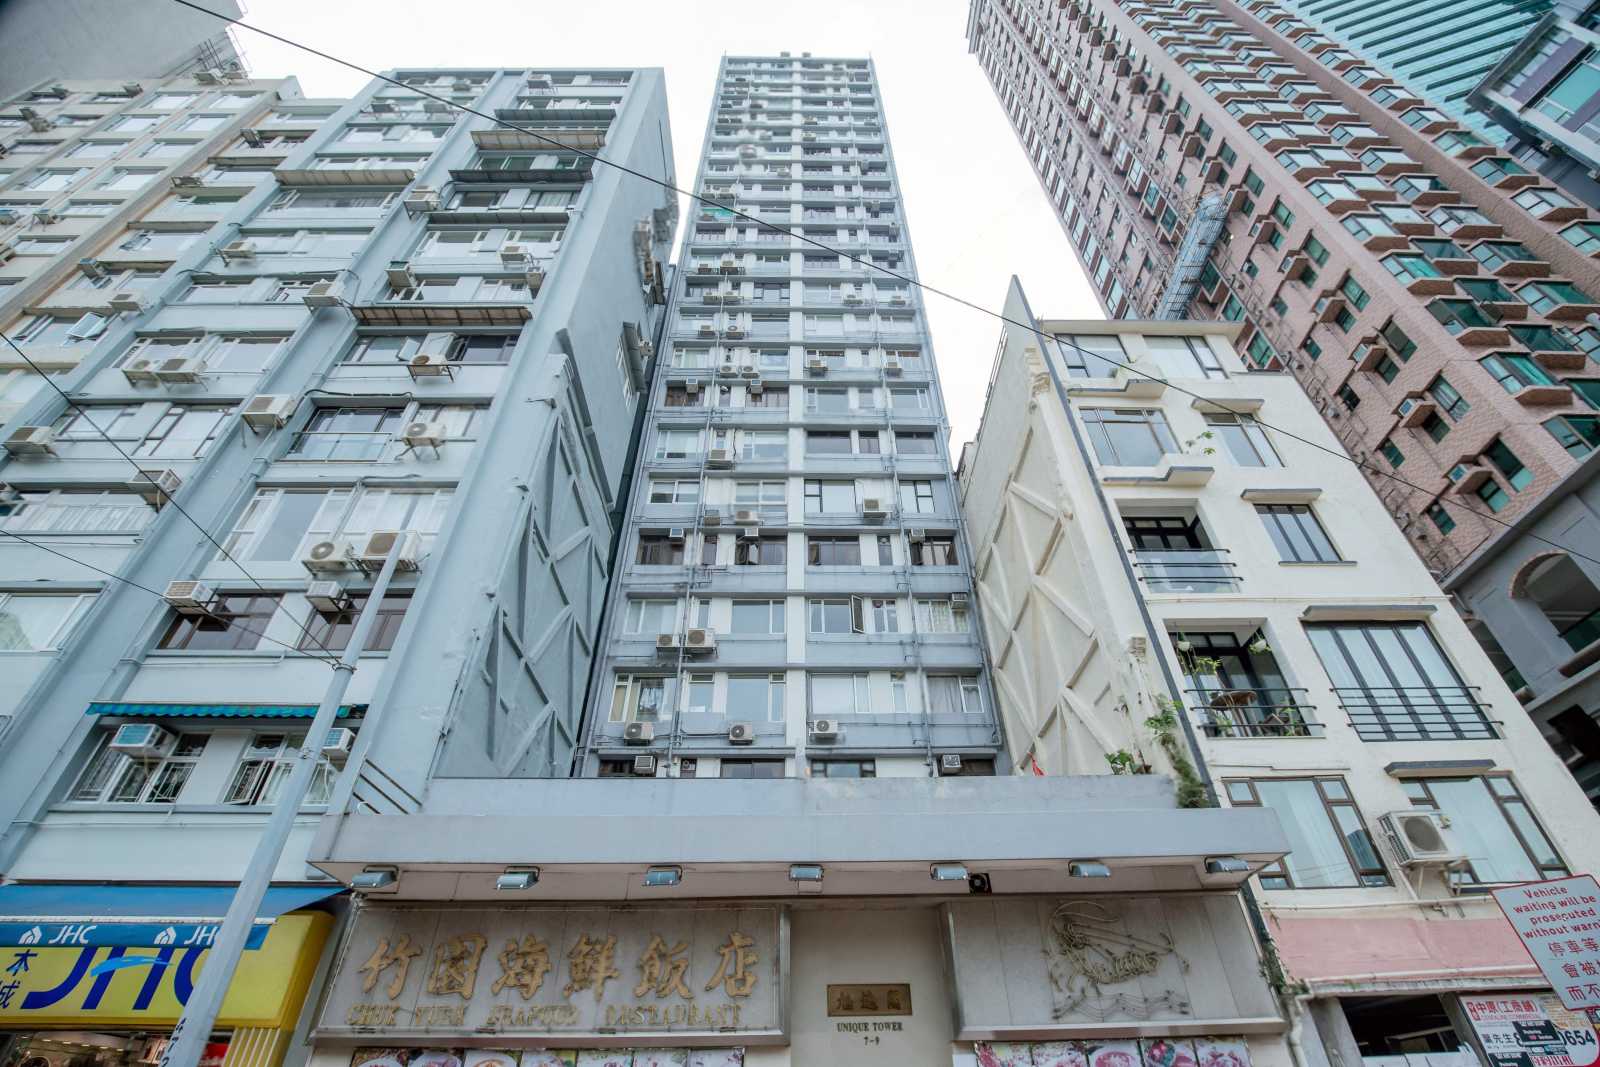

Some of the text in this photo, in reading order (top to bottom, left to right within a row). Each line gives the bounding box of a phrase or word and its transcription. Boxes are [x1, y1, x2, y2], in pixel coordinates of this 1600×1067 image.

[1523, 886, 1568, 899] Vehicle
[1513, 894, 1597, 914] waiting will be
[1530, 907, 1596, 926] prosecuted
[48, 925, 97, 944] JHC
[1523, 919, 1600, 940] without warn
[1562, 960, 1600, 979] 會被
[605, 1003, 743, 1026] RESTAURANT
[836, 1022, 903, 1033] UNIQUE TOWER
